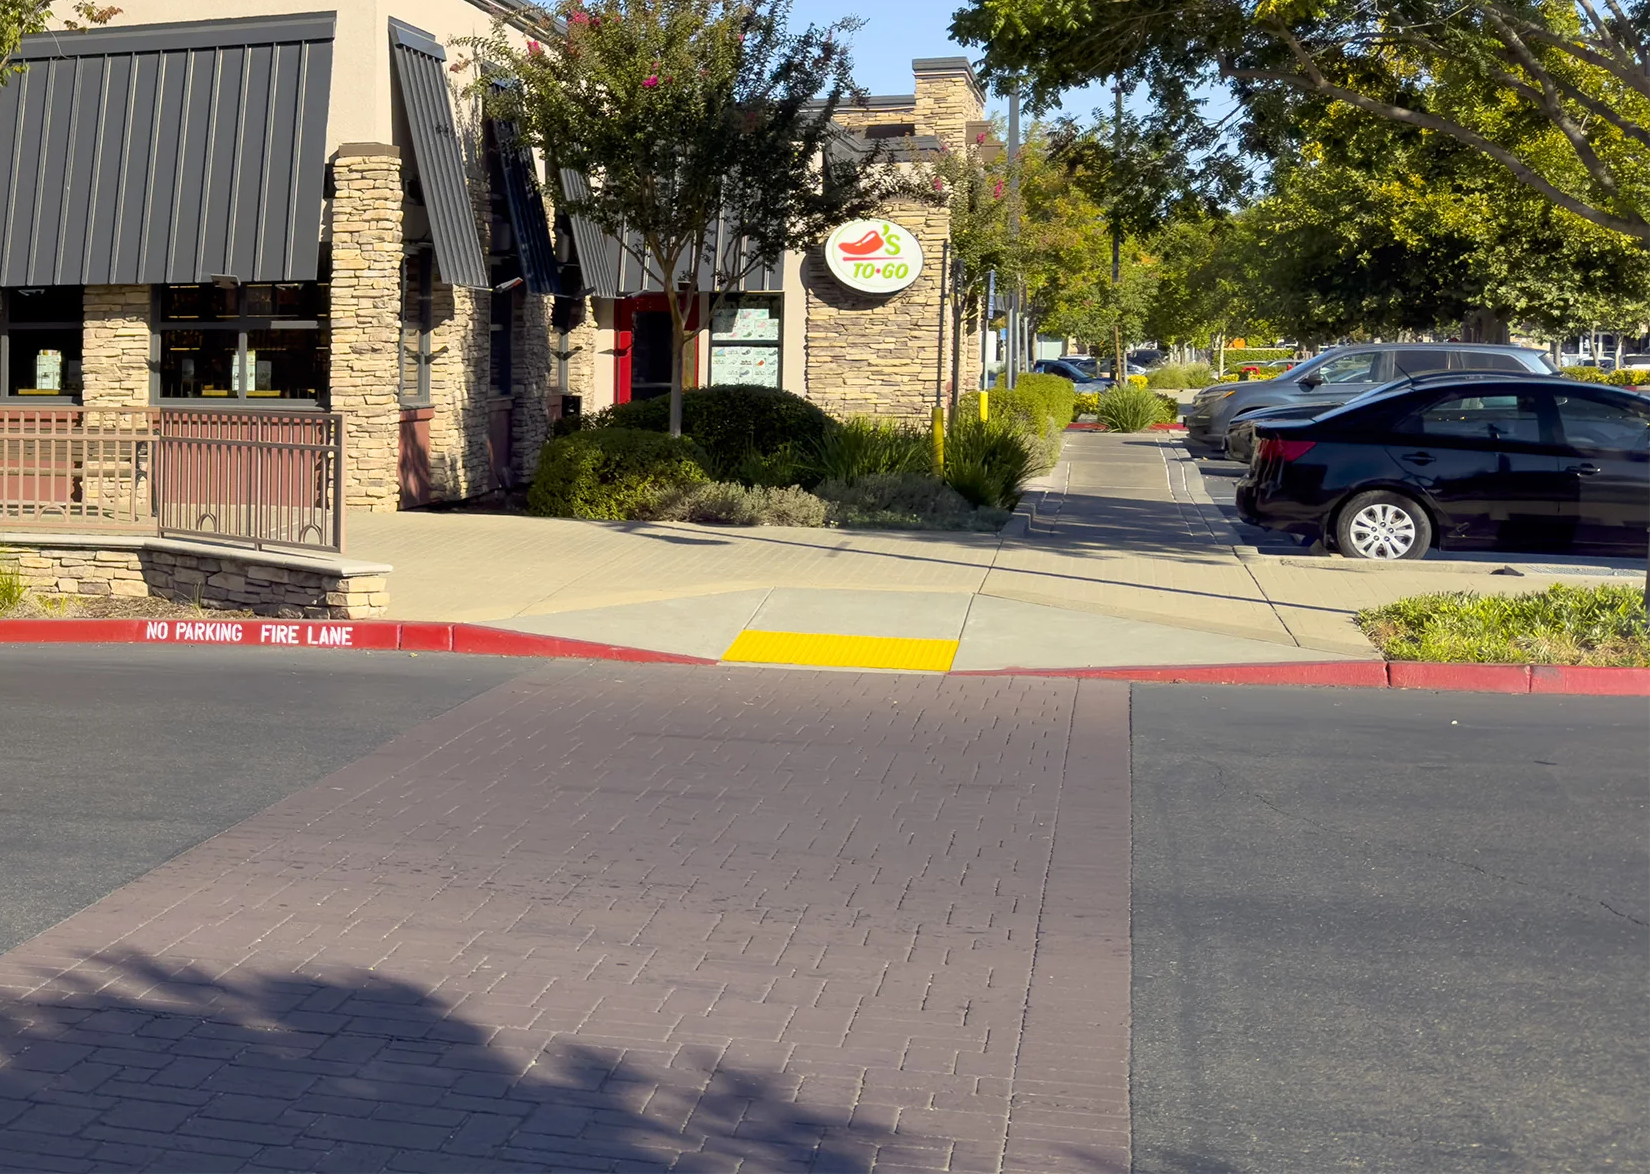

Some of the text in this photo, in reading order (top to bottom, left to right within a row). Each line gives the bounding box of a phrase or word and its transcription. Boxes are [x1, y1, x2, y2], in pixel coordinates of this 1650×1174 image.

[146, 621, 353, 646] NO PARKING FIRE LANE
